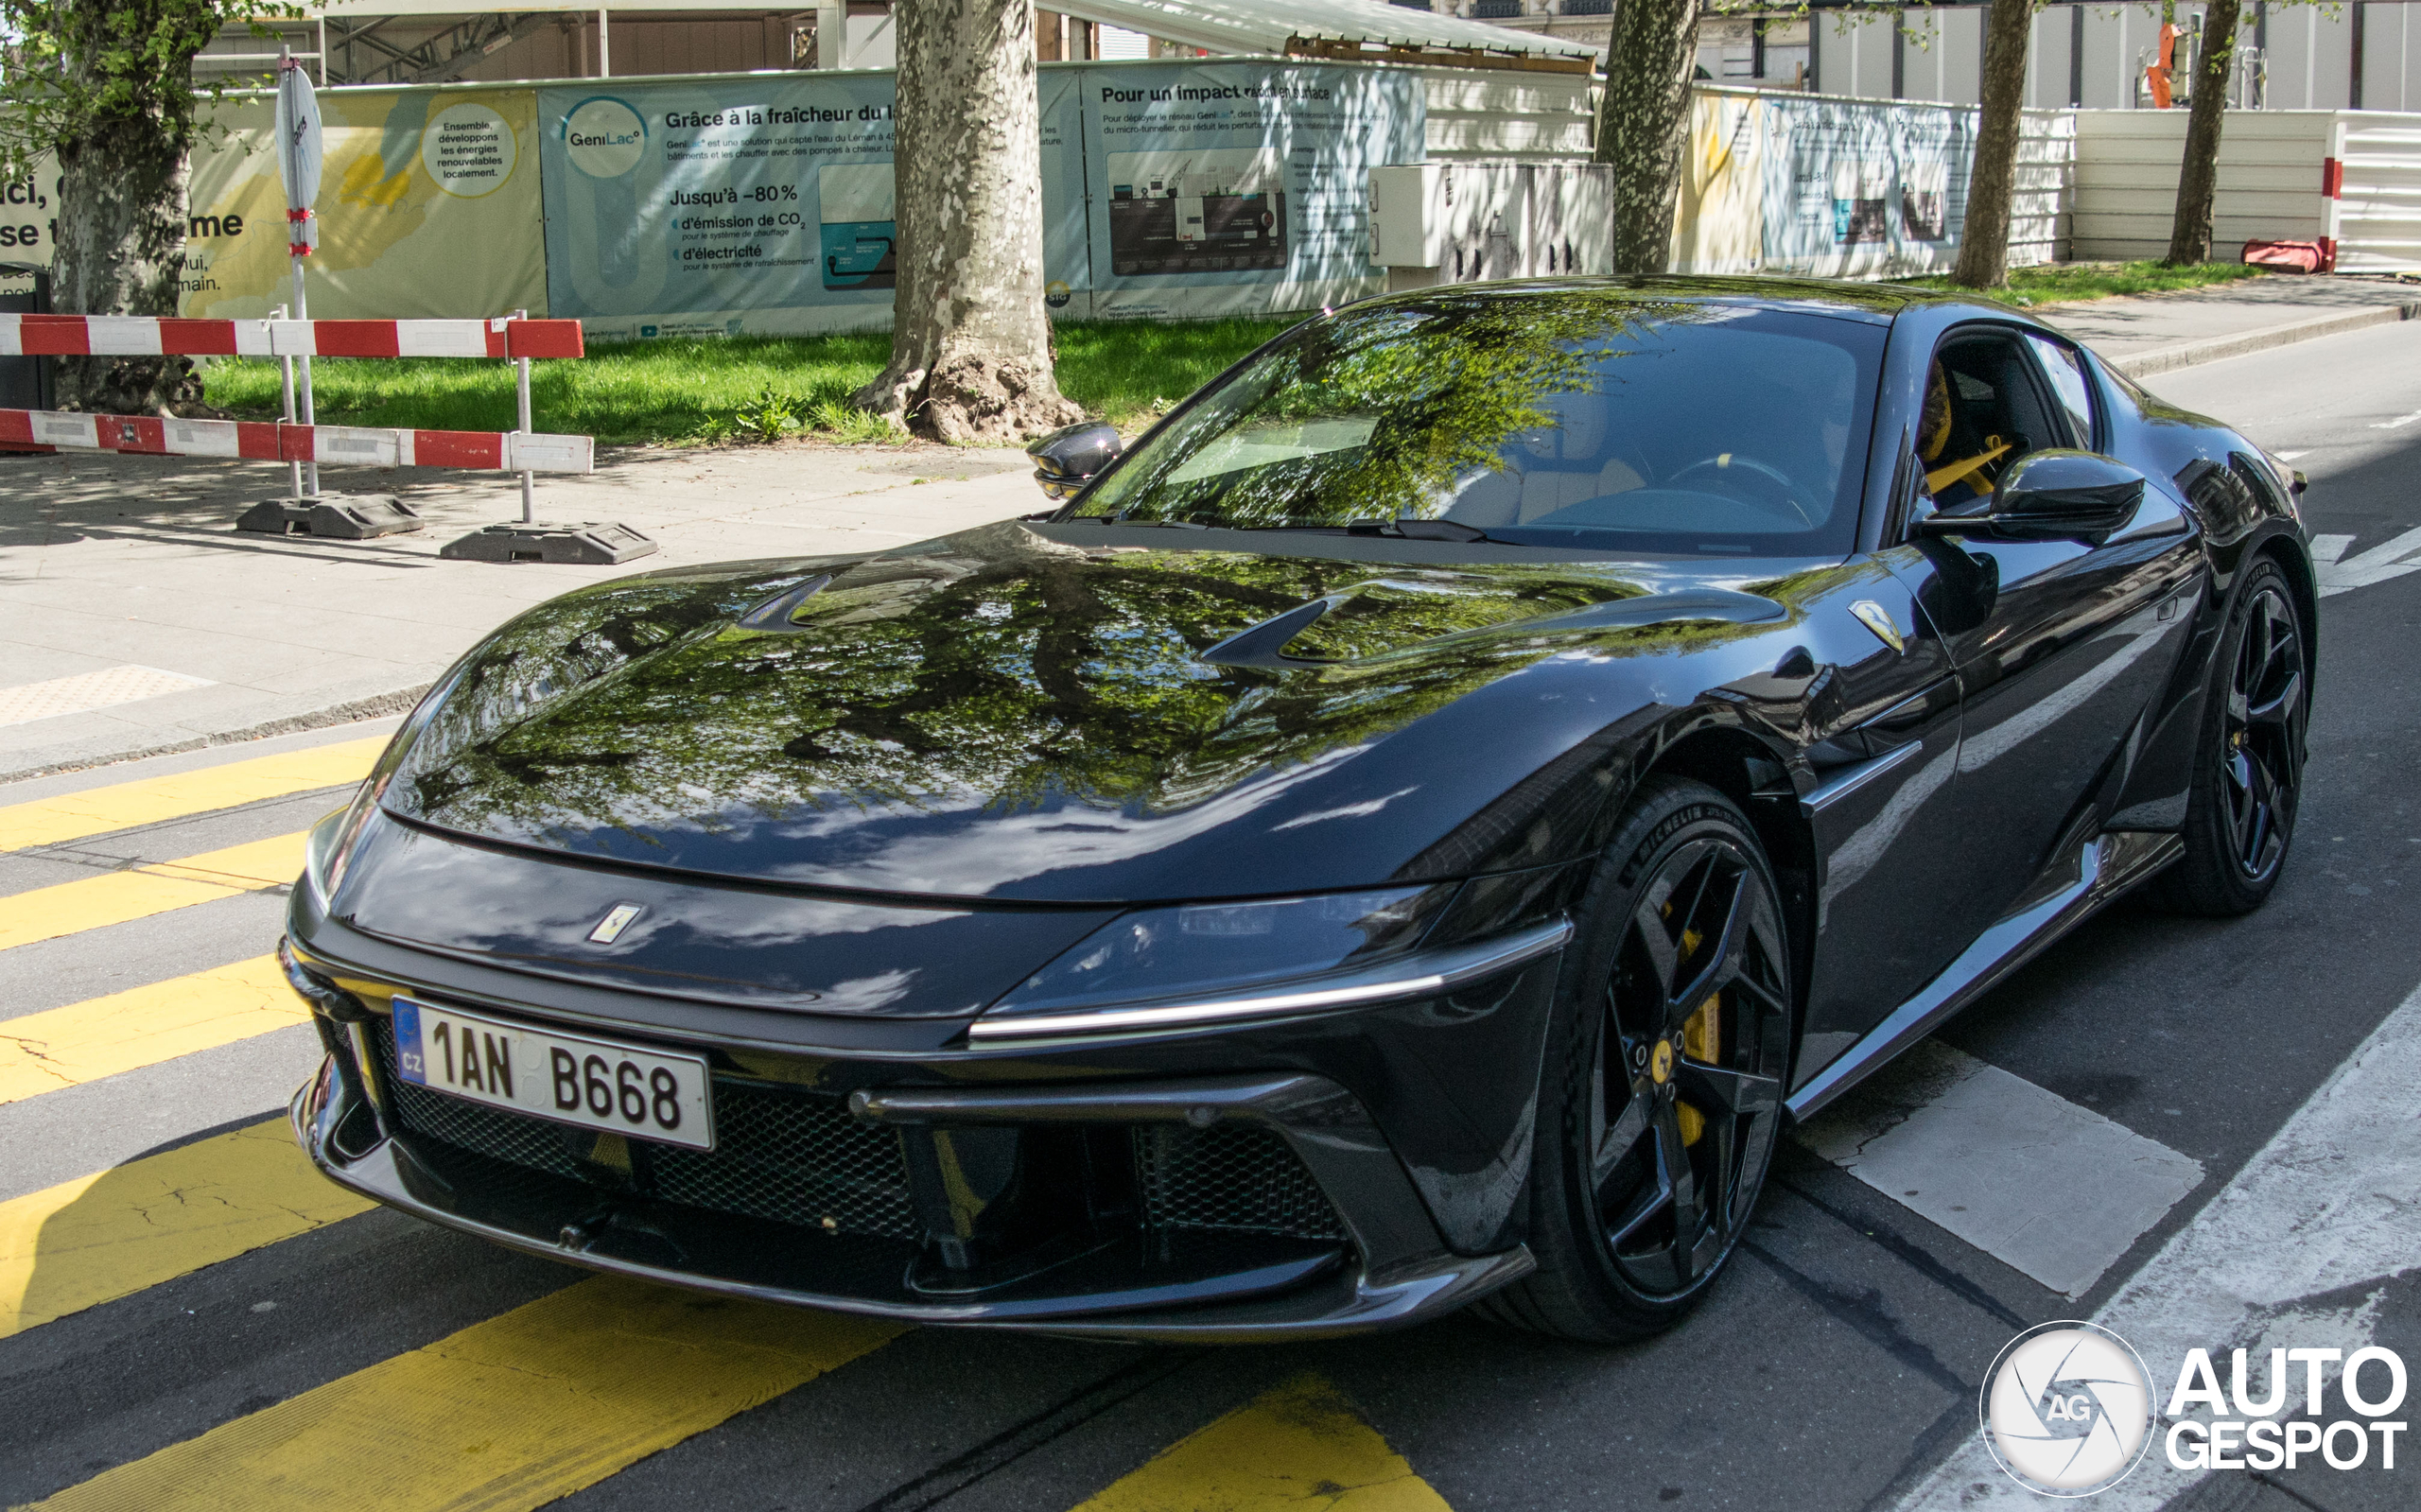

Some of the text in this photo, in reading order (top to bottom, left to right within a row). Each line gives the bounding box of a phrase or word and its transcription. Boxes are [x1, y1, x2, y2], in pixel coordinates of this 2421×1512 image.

[1101, 87, 1144, 102] Pour
[1150, 88, 1172, 101] un
[1176, 85, 1241, 103] impact
[665, 111, 723, 129] Grâce
[729, 109, 740, 126] à
[746, 109, 762, 125] la
[768, 106, 853, 124] fraîcheur
[858, 104, 882, 121] du
[444, 121, 493, 131] Ensemble,
[438, 133, 498, 144] développons
[441, 145, 498, 155] les énergies
[437, 156, 502, 167] renouvelables
[443, 168, 498, 179] localement.
[670, 187, 738, 208] Jusqu'à
[681, 215, 754, 231] d'émission
[758, 214, 775, 227] de
[683, 244, 762, 261] d'électricité
[1048, 293, 1068, 302] SIG
[402, 1051, 423, 1074] CZ
[433, 1020, 681, 1131] 1AN B668
